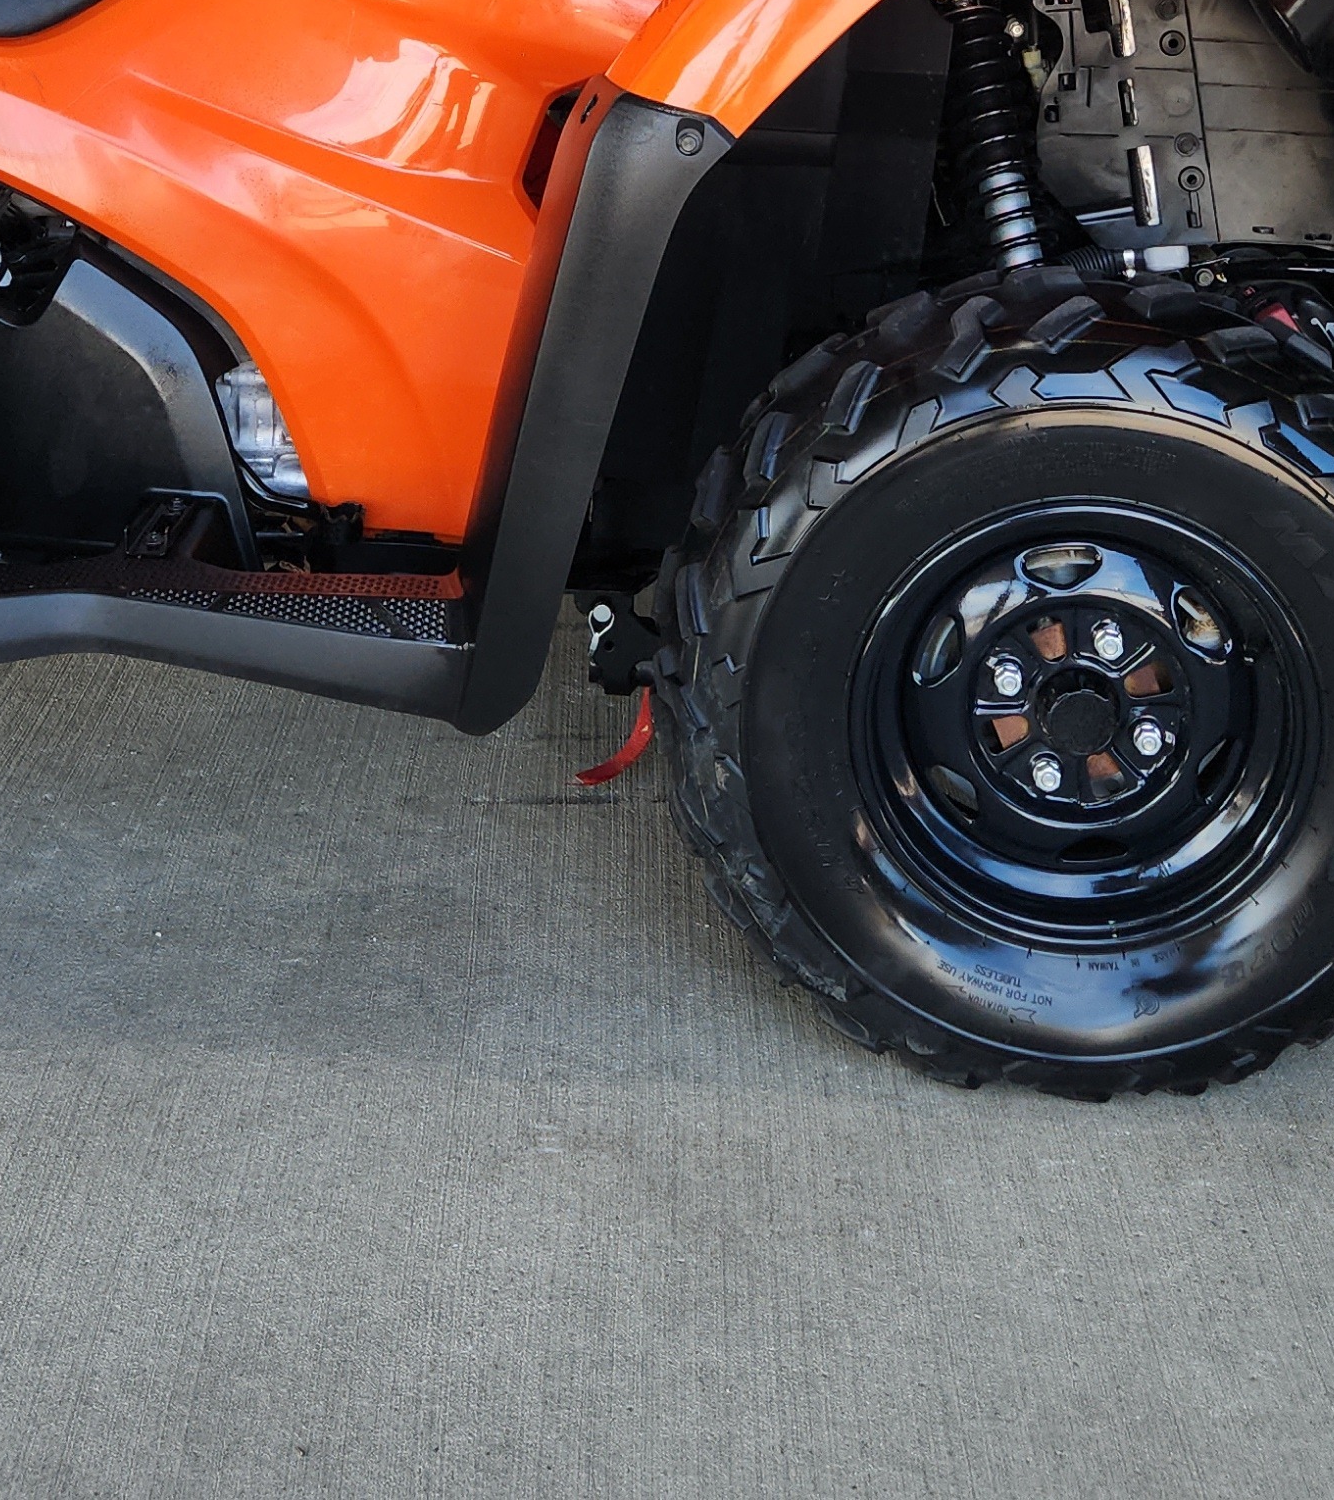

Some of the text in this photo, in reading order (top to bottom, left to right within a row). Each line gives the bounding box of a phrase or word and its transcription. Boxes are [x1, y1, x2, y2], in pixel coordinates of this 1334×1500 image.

[958, 970, 1003, 997] HIGHWAY
[973, 963, 1022, 988] TUBELESS
[1005, 986, 1028, 1002] FOR
[1030, 993, 1054, 1007] NOT
